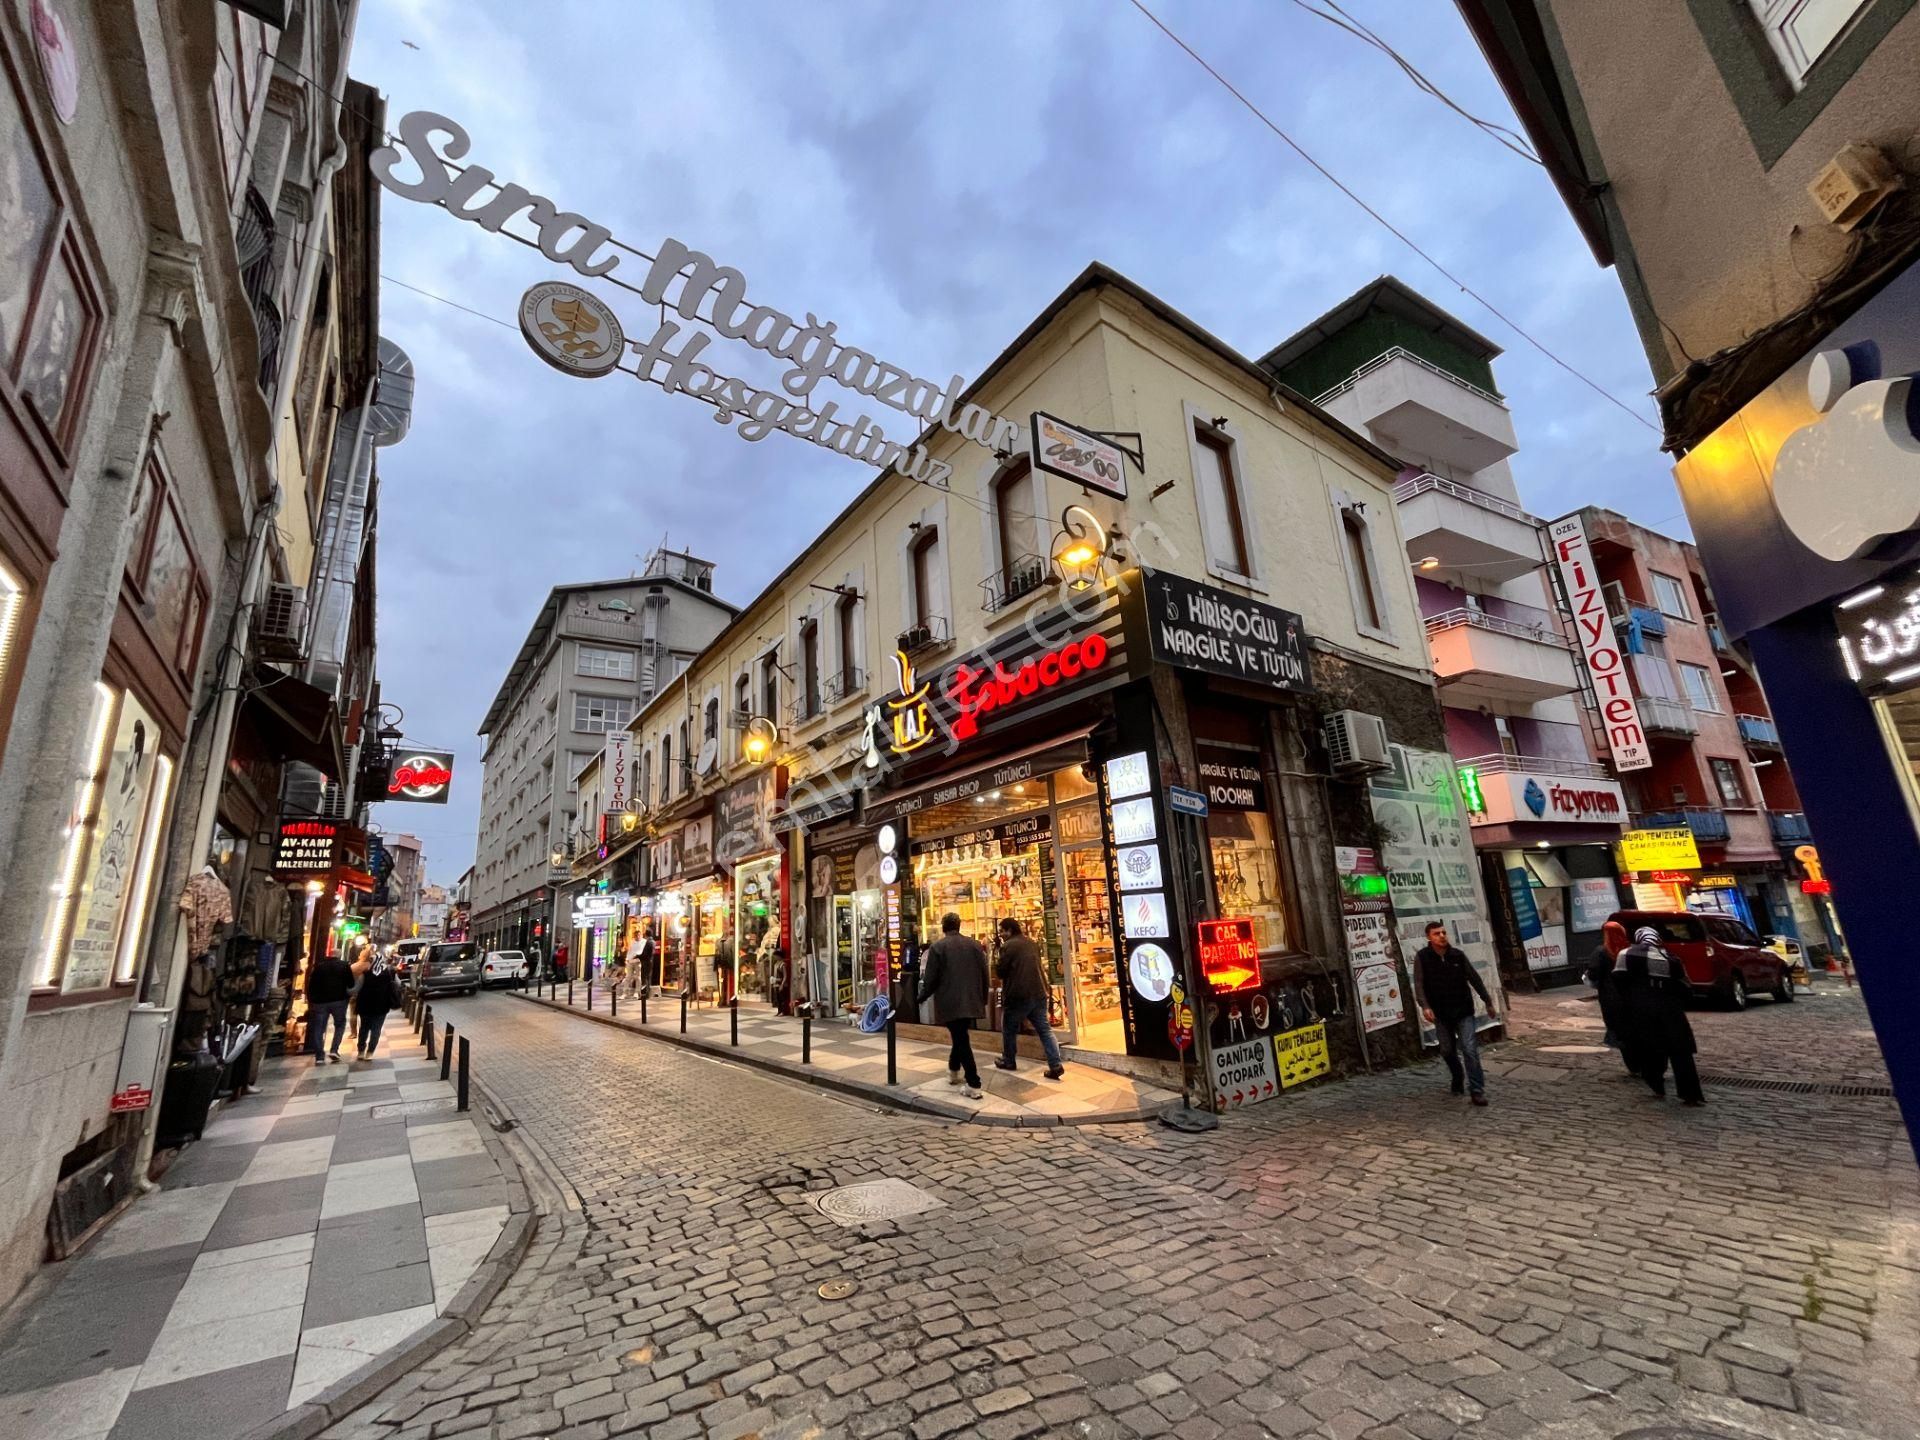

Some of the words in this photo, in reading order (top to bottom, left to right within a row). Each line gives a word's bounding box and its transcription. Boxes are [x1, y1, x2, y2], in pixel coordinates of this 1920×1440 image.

[641, 238, 1020, 454] Mağazalar
[632, 320, 954, 492] Hoşgeldiniz
[1556, 524, 1577, 536] ÖZEL
[1187, 590, 1279, 645] KİRİŞOĞLU
[1160, 620, 1233, 665] NARGİLE
[1235, 643, 1259, 675] VE
[1260, 647, 1305, 684] TÜTÜN
[1623, 749, 1637, 758] TIP
[958, 779, 980, 797] SHOP
[993, 761, 1031, 785] TÜTÜNCÜ
[1228, 767, 1239, 781] VE
[1210, 785, 1255, 806] HOOKAH
[1005, 817, 1038, 836] TÜTÜNCÜ
[281, 838, 334, 848] AV-KAMP
[296, 849, 331, 858] BALIK
[1134, 926, 1157, 937] KEFO
[1203, 942, 1255, 965] PARKING
[1217, 1046, 1254, 1068] GANİTA
[1219, 1062, 1266, 1087] OTOPARK
